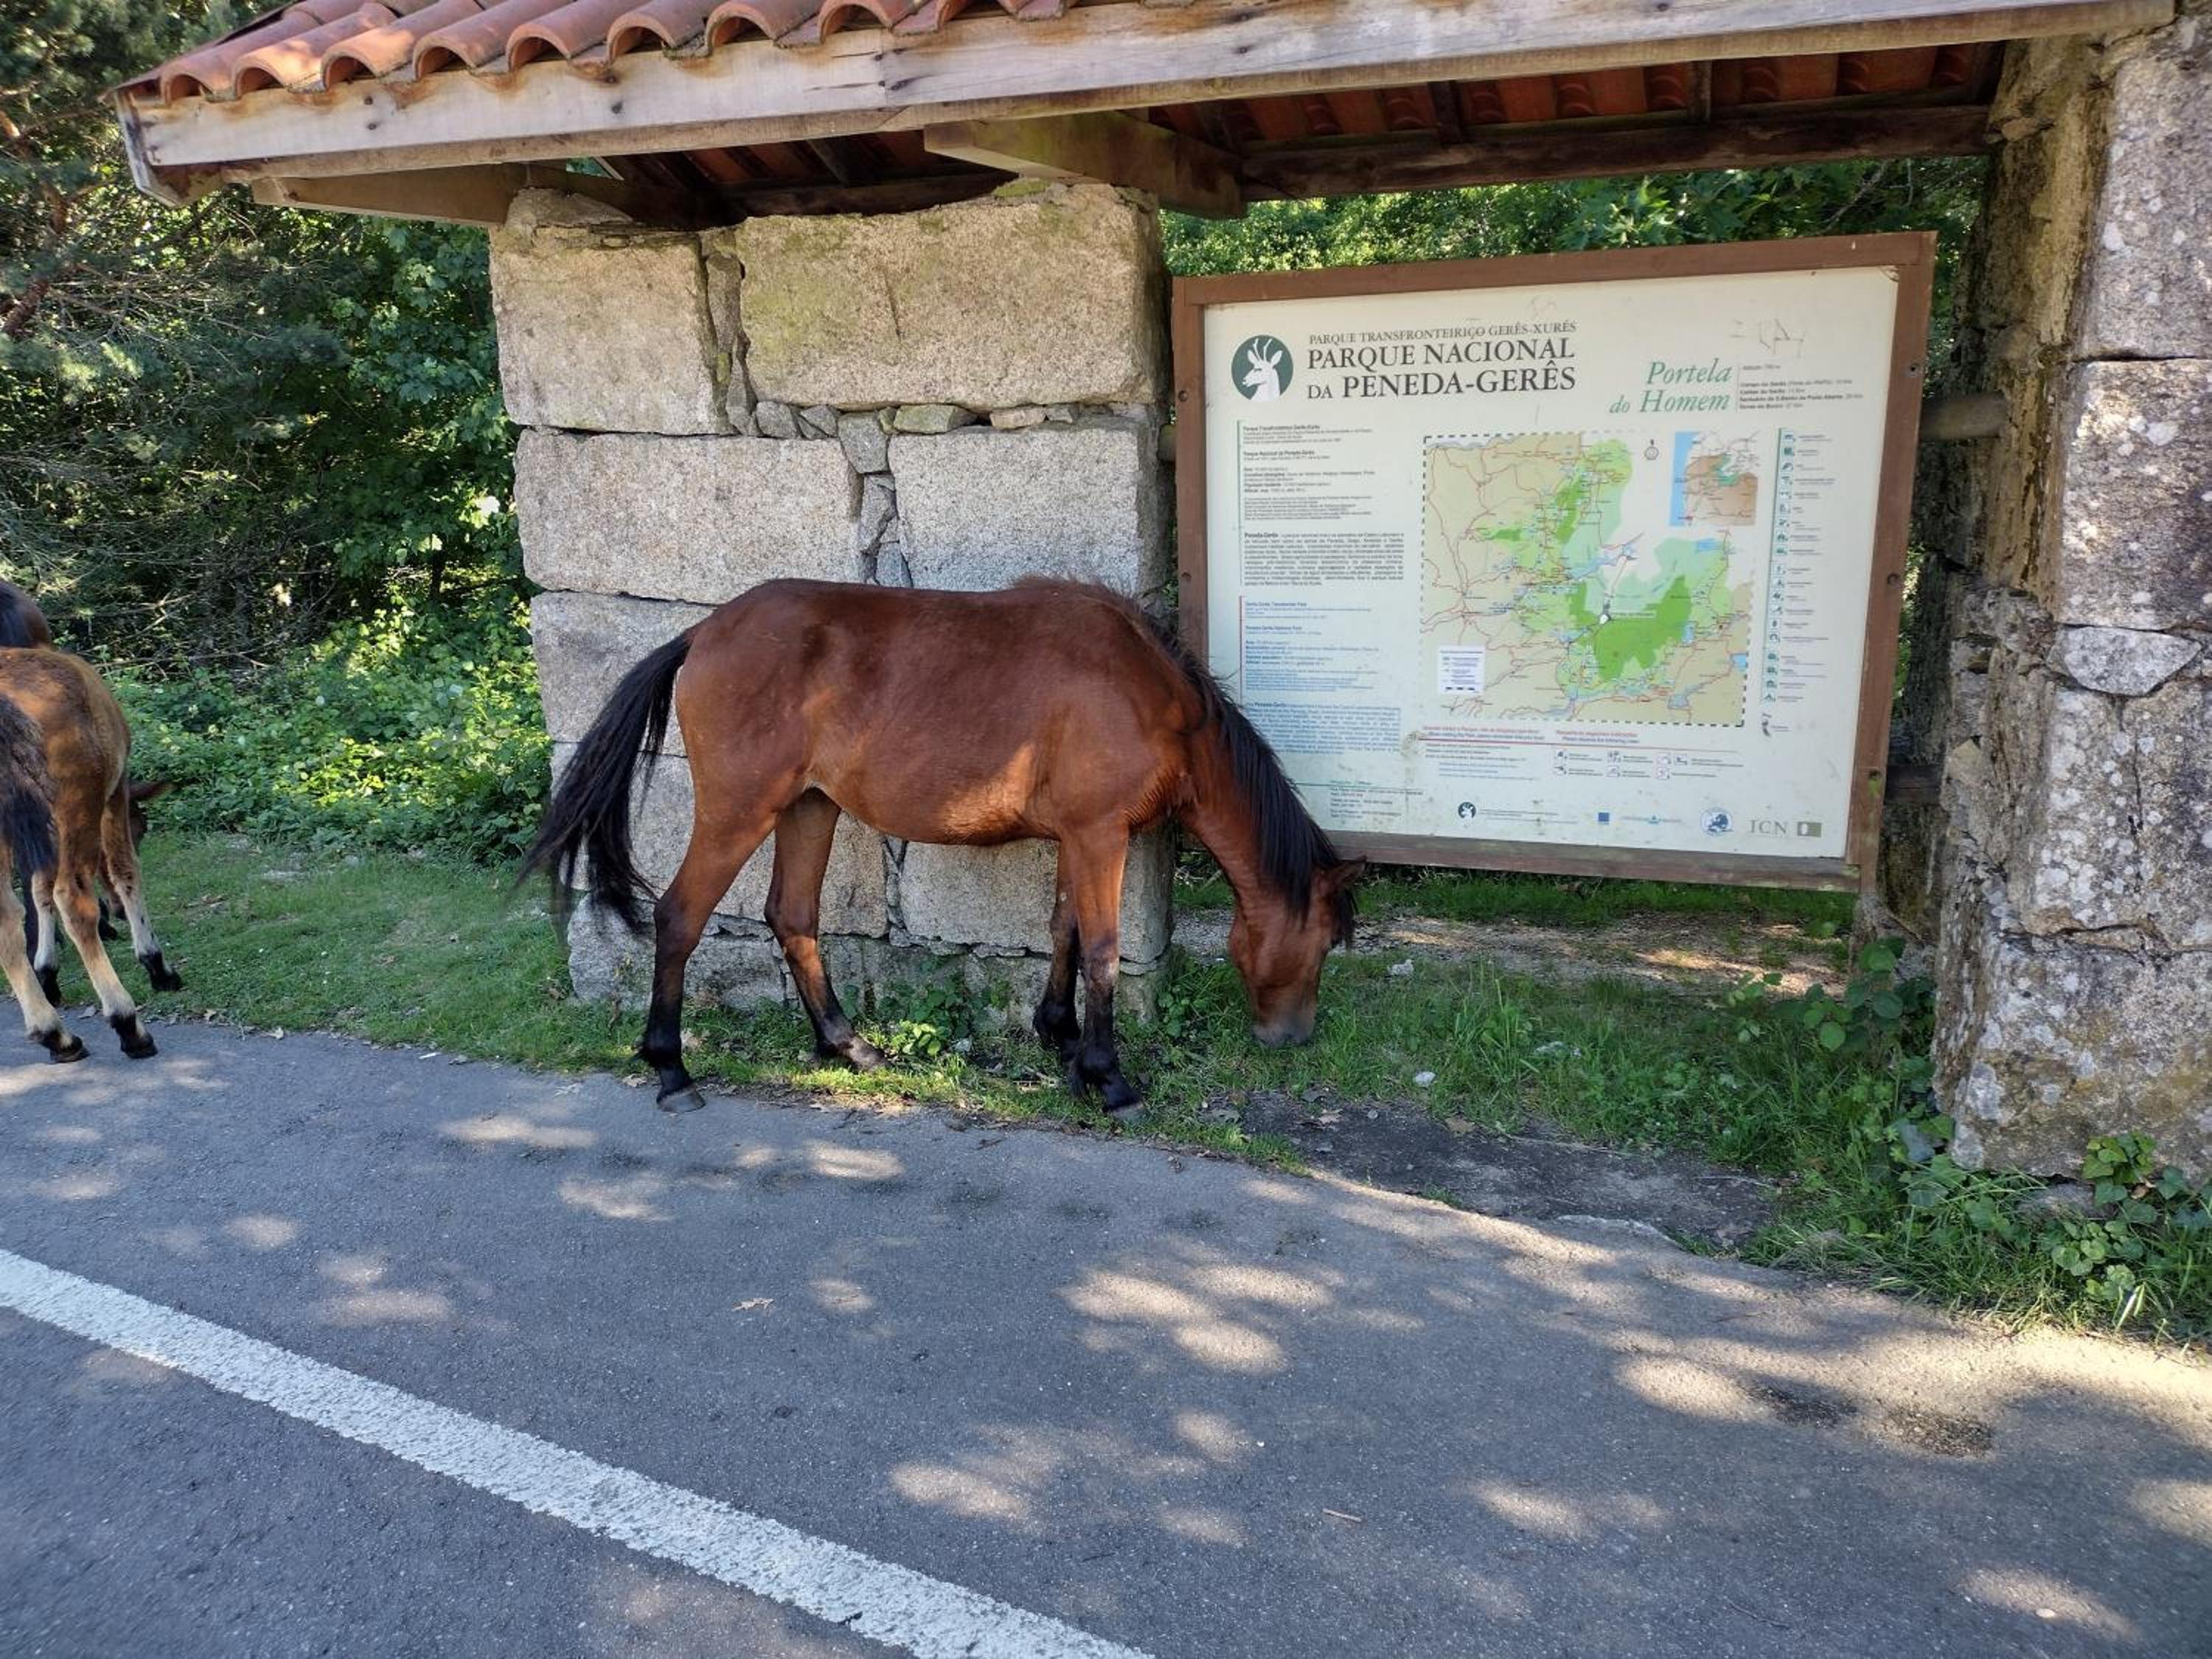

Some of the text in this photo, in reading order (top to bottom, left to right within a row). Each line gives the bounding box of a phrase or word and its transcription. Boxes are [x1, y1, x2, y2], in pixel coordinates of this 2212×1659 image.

[1310, 319, 1577, 345] PARQUE TRANSFRONTEIRIÇO GERÊS-XURÉS
[1307, 337, 1575, 372] PARQUE NACIONAL
[1308, 360, 1576, 399] DA PENEDA-GERÊS
[1646, 358, 1733, 384] Portela
[1609, 394, 1630, 414] do
[1639, 389, 1731, 413] Homem
[1749, 819, 1787, 835] ICN
